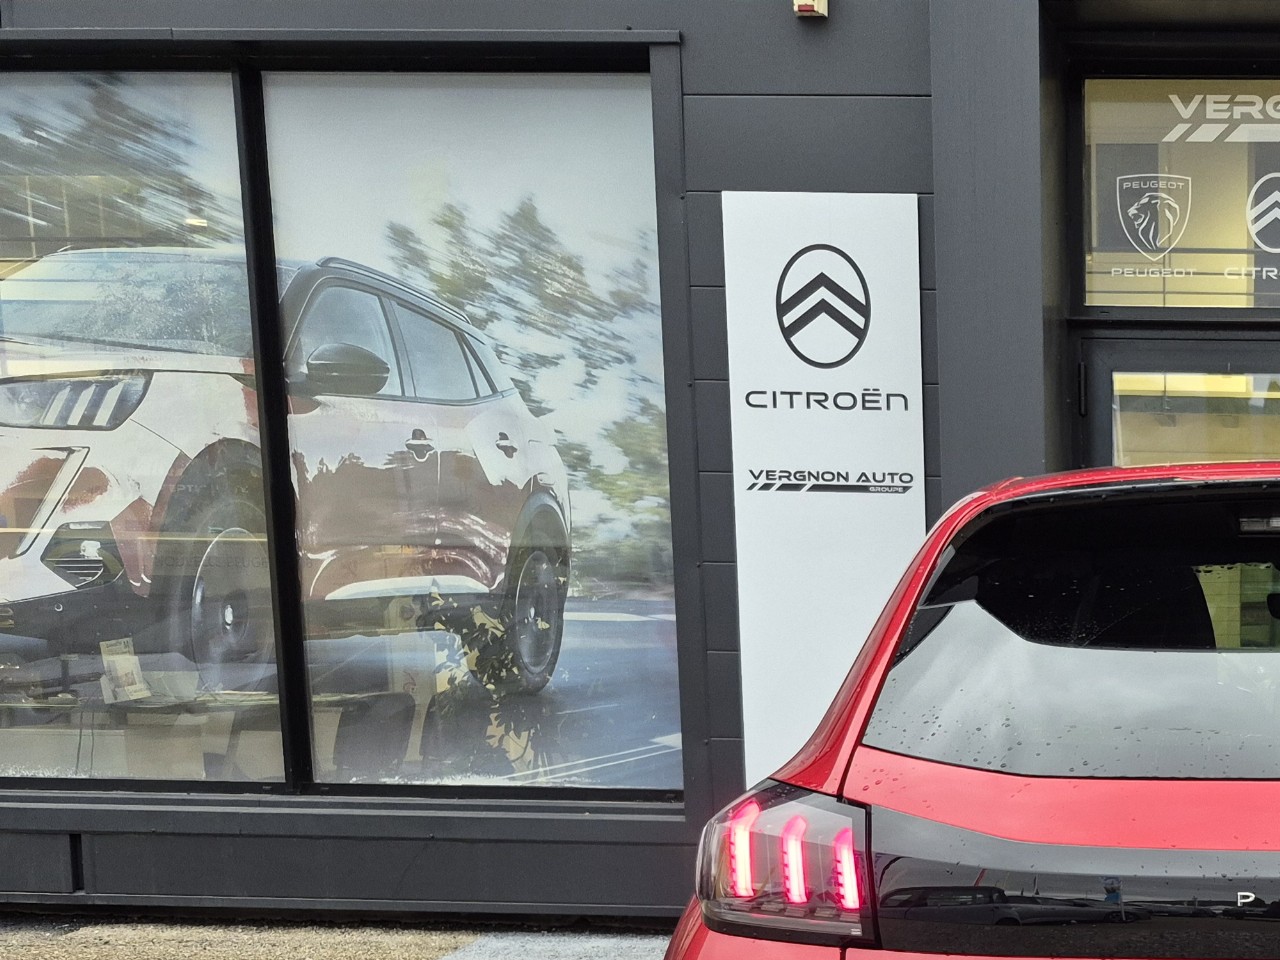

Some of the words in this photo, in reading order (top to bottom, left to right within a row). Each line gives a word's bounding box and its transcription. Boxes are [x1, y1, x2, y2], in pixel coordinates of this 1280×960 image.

[1122, 180, 1185, 191] PEUGEOT
[1110, 267, 1198, 279] PEUGEOT
[748, 469, 849, 484] VERGNON
[855, 471, 914, 484] AUTO
